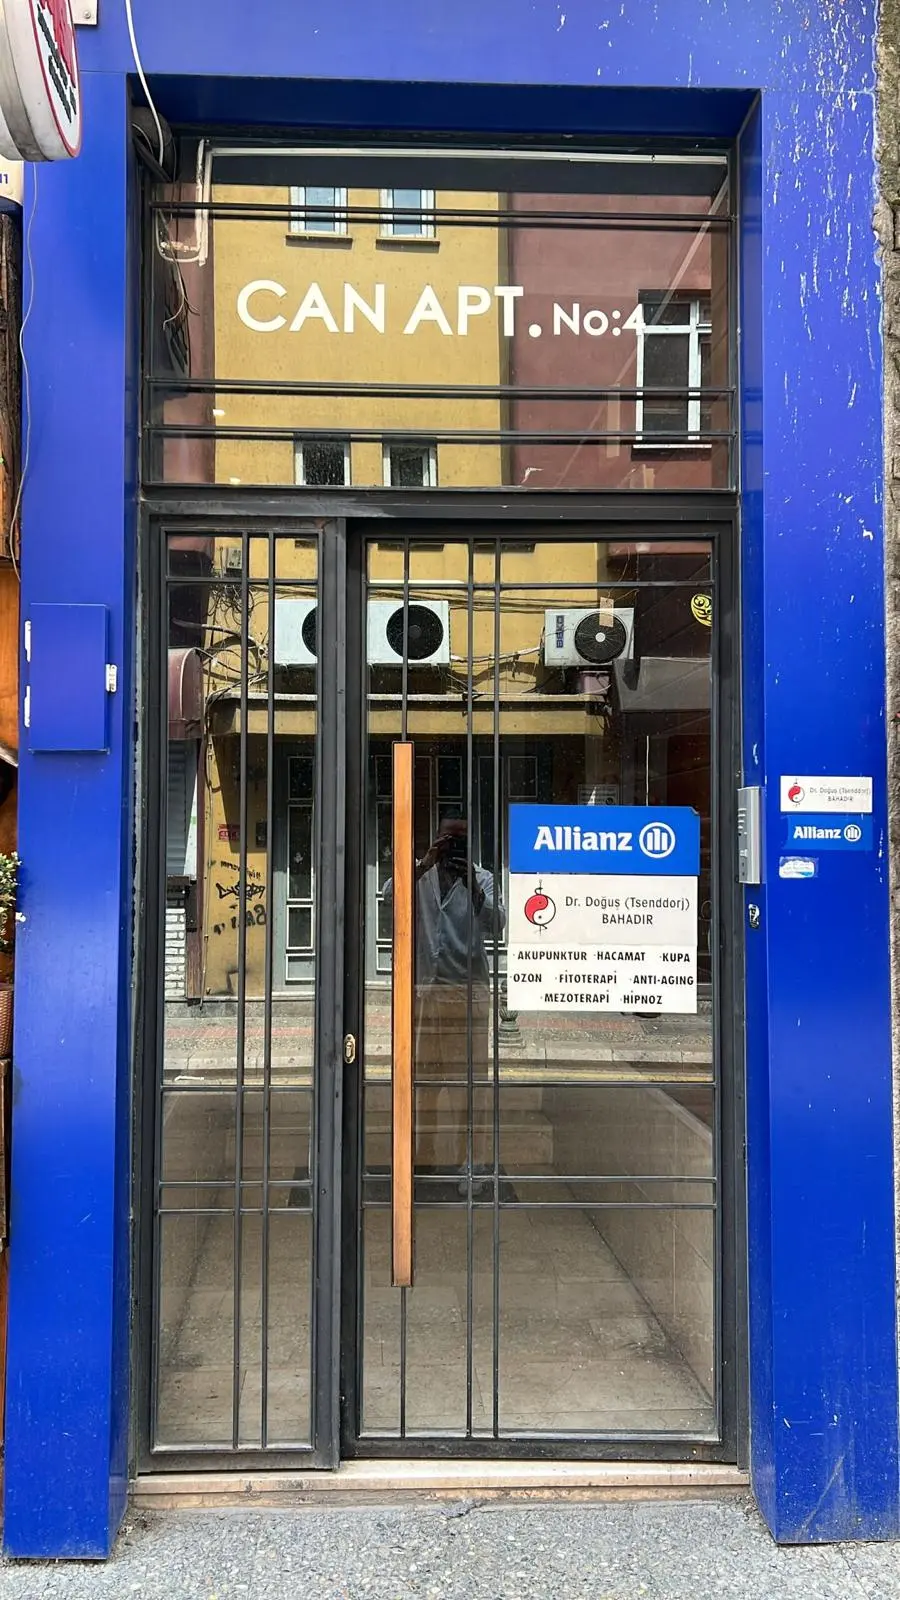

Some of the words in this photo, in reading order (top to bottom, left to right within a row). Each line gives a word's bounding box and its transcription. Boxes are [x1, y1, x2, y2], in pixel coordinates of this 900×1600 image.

[236, 279, 386, 334] CAN
[403, 283, 543, 338] APT.
[552, 303, 646, 338] No:4
[533, 826, 633, 851] Allianz
[793, 826, 842, 839] Allianz
[565, 896, 581, 907] Dr.
[585, 895, 620, 910] Doğuş
[624, 896, 690, 911] (Tsenddorj)
[601, 914, 653, 925] BAHADIR
[517, 951, 587, 961] AKUPUNKTUR
[596, 951, 646, 961] HACAMAT
[662, 952, 691, 962] KUPA
[513, 973, 542, 983] OZON
[559, 969, 617, 984] FİTOTERAPİ
[633, 975, 694, 985] ANTI-AGING
[544, 989, 610, 1003] MEZOTERAPİ
[623, 990, 663, 1005] HİPNOZ
